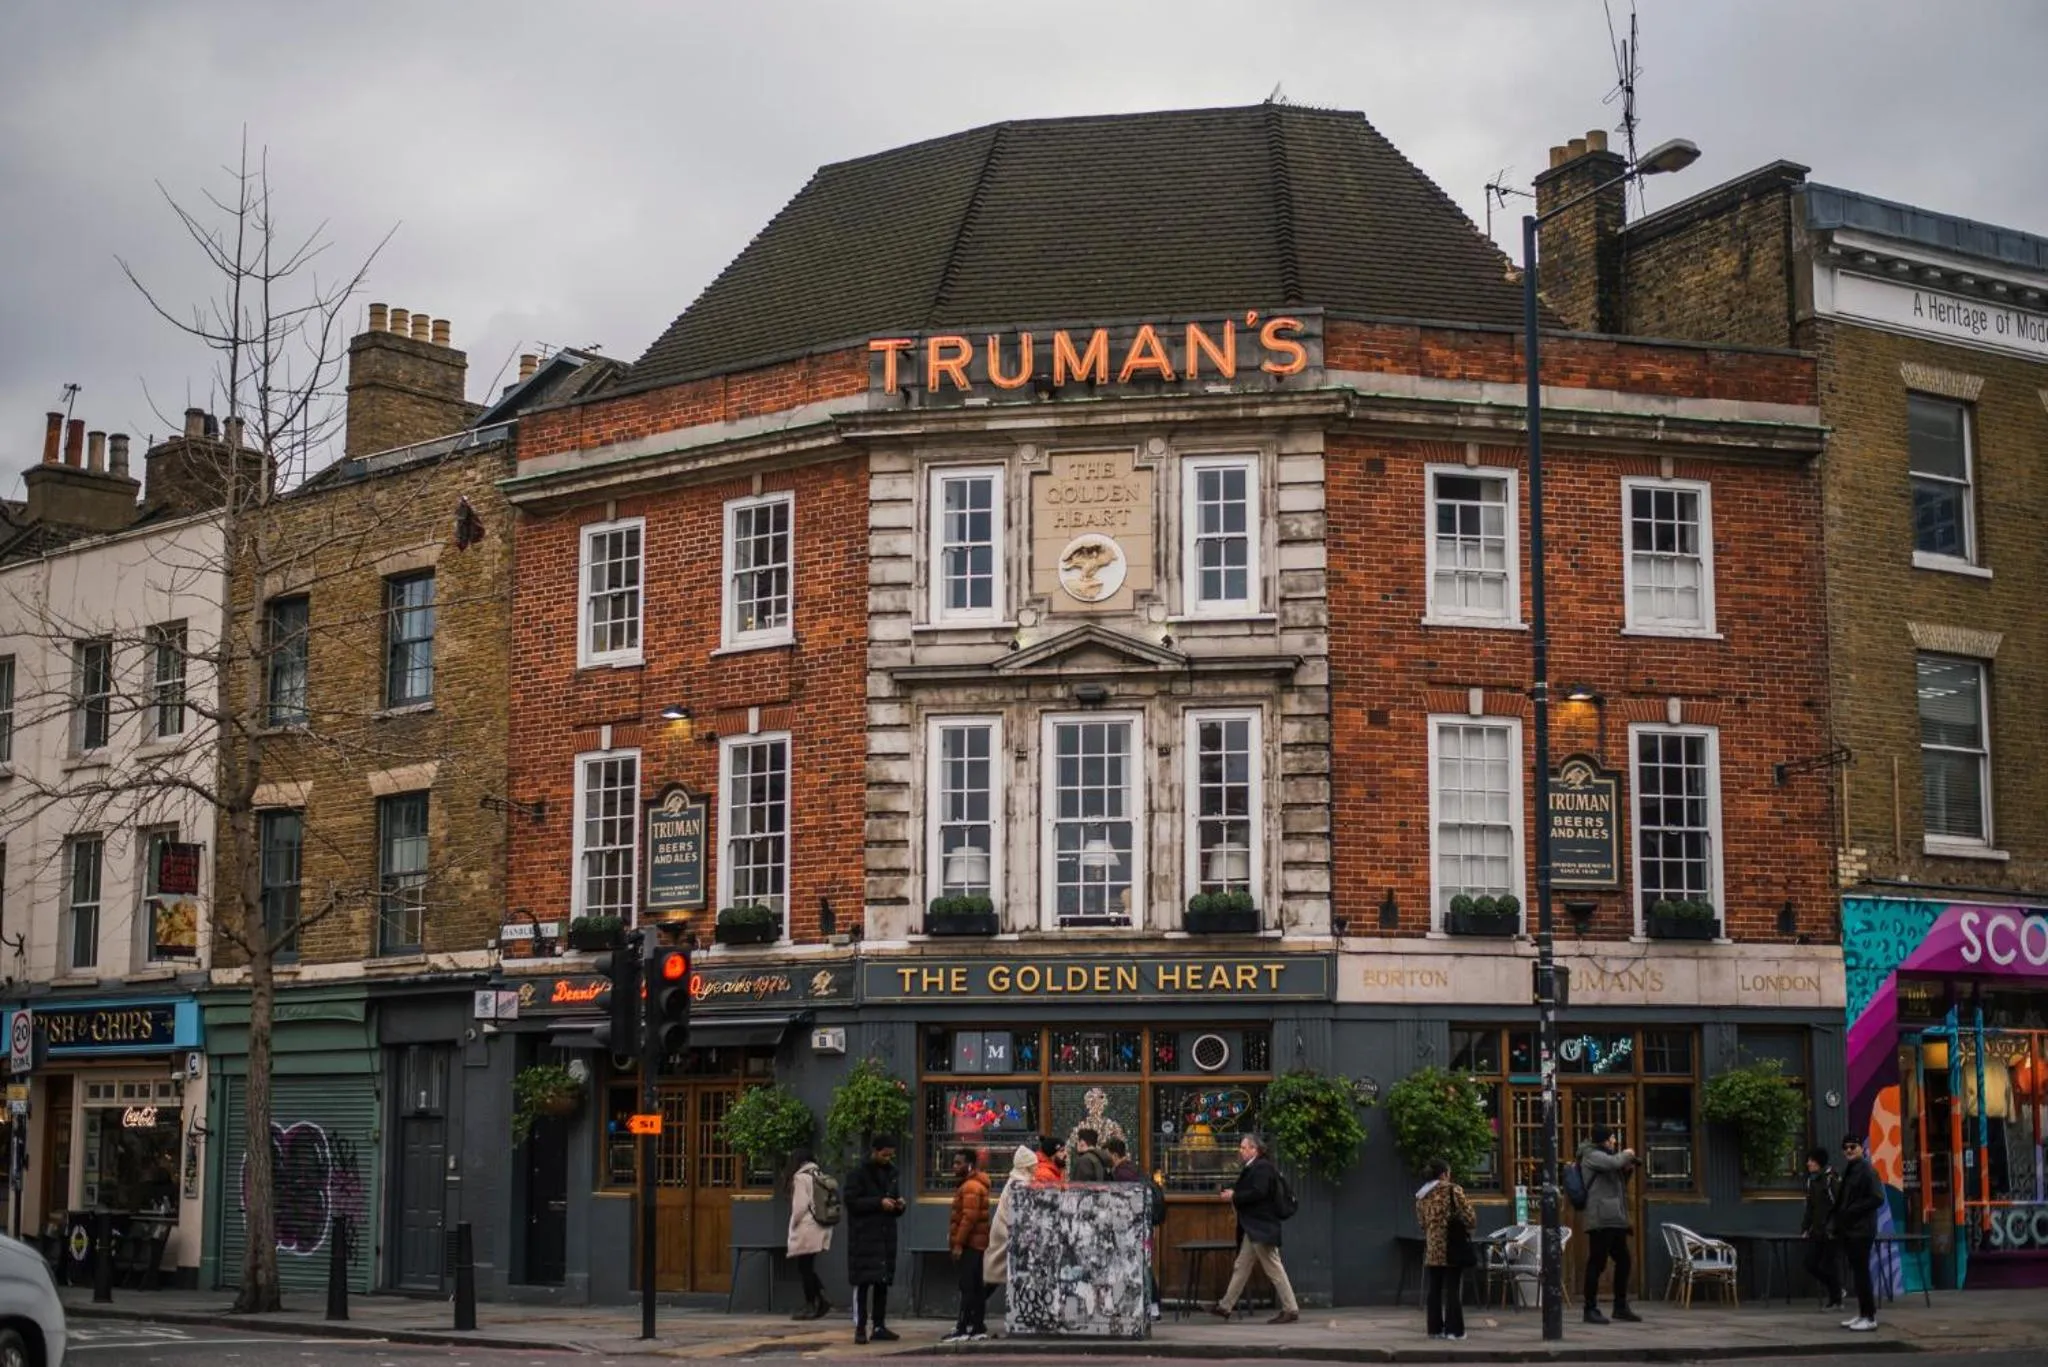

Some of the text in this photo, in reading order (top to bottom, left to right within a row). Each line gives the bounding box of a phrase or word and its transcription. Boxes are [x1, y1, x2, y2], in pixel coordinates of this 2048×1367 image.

[1914, 291, 2048, 343] A Heritage of Mod
[868, 308, 1308, 395] TRUMAN'S
[1069, 462, 1116, 481] THE
[1046, 483, 1141, 505] GOLDEN
[1053, 508, 1132, 529] HEART
[1548, 793, 1610, 812] TRUMAN
[652, 819, 700, 838] TRUMAN
[1553, 816, 1604, 827] BEERS
[1550, 828, 1609, 840] AND ALES
[658, 841, 694, 853] BEERS
[654, 852, 698, 865] AND ALES
[1960, 911, 2048, 966] SCO
[897, 963, 1286, 993] THE GOLDEN HEART
[1570, 967, 1665, 993] UMAN'S
[1741, 973, 1821, 993] LONDON
[15, 1024, 29, 1042] 20
[91, 1010, 153, 1041] CHIPS
